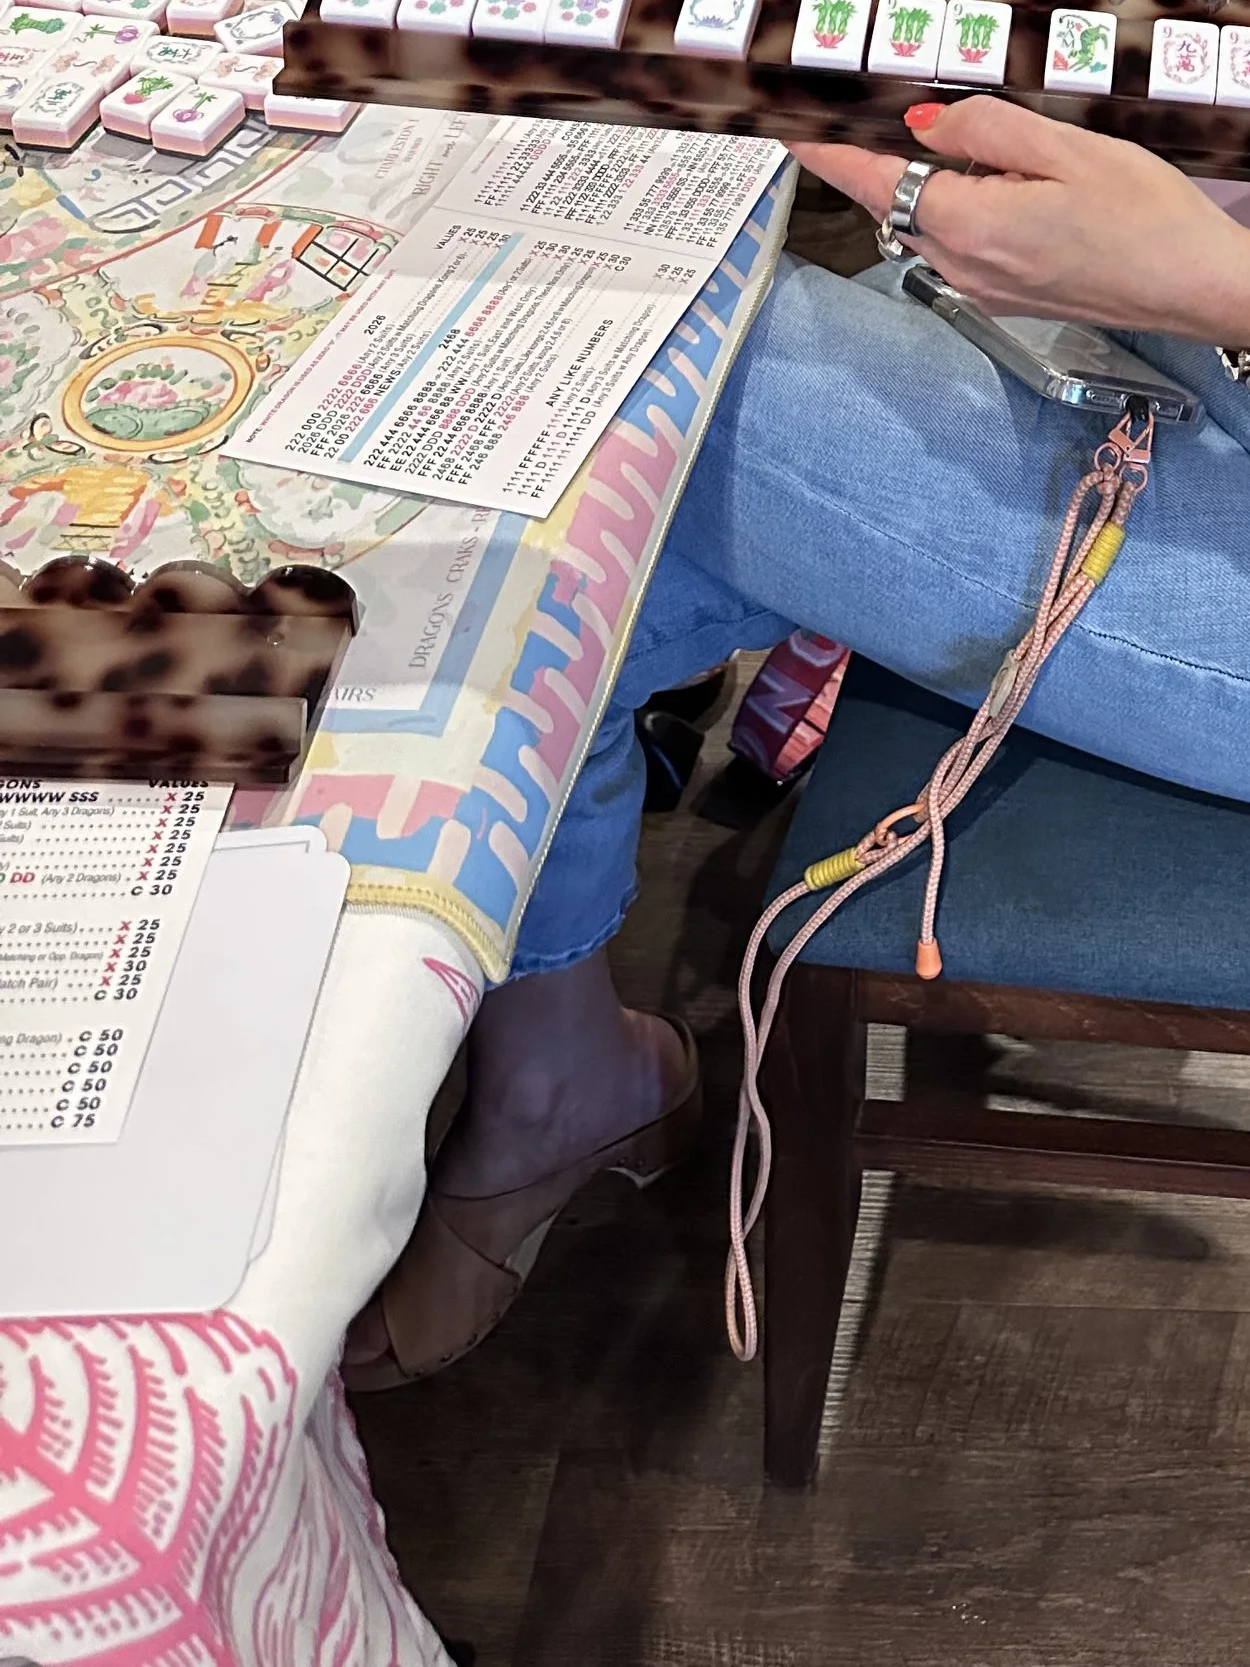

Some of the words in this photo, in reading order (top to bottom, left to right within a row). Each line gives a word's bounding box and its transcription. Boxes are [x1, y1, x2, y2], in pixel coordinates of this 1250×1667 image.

[953, 2, 963, 16] 9
[1163, 26, 1172, 38] 9
[1230, 32, 1239, 44] 9
[411, 161, 444, 197] RIGHT
[435, 225, 460, 249] VALUES
[363, 315, 385, 334] 2026
[284, 432, 305, 450] 222
[301, 412, 321, 430] 000
[317, 388, 342, 410] 2222
[338, 364, 361, 385] 6666
[463, 227, 476, 236] 25
[310, 437, 328, 455] FFF
[326, 414, 349, 435] 2026
[345, 396, 364, 412] 222
[360, 374, 382, 394] 6666
[486, 232, 499, 240] 25
[438, 329, 460, 348] 2468
[323, 446, 339, 458] 22
[334, 433, 349, 444] 00
[344, 415, 363, 431] 222
[359, 398, 377, 413] 666
[373, 370, 400, 395] NEWS
[498, 234, 511, 242] 30
[376, 456, 390, 468] FF
[388, 431, 411, 454] 2222
[408, 418, 421, 429] 44
[417, 405, 431, 416] 66
[428, 382, 450, 403] 8888
[545, 242, 558, 251] 30
[545, 386, 563, 406] ANY
[560, 364, 580, 384] LIKE
[576, 319, 612, 362] NUMBERS
[458, 471, 471, 484] FF
[469, 453, 487, 470] 246
[483, 433, 502, 450] 888
[497, 414, 515, 430] 246
[511, 395, 529, 411] 888
[618, 256, 631, 265] 30
[446, 536, 479, 584] CRAKS
[408, 592, 453, 669] DRAGONS
[69, 791, 99, 803] SSS
[182, 791, 205, 802] 25
[178, 804, 200, 814] 25
[173, 817, 196, 827] 25
[170, 829, 192, 840] 25
[164, 842, 187, 853] 25
[159, 856, 182, 867] 25
[10, 872, 35, 883] DD
[154, 870, 177, 880] 25
[130, 886, 143, 896] C
[149, 884, 173, 895] 30
[137, 919, 160, 931] 25
[132, 933, 156, 945] 25
[128, 946, 152, 958] 25
[123, 960, 147, 972] 30
[118, 974, 142, 986] 25
[94, 990, 107, 1001] C
[113, 988, 138, 1000] 30
[79, 1030, 92, 1042] C
[99, 1028, 124, 1042] 50
[74, 1045, 87, 1057] C
[93, 1043, 119, 1056] 50
[67, 1062, 81, 1074] C
[88, 1061, 113, 1074] 50
[61, 1080, 75, 1093] C
[81, 1078, 107, 1092] 50
[56, 1098, 70, 1111] C
[76, 1096, 101, 1110] 50
[50, 1115, 65, 1128] C
[72, 1113, 96, 1128] 75
